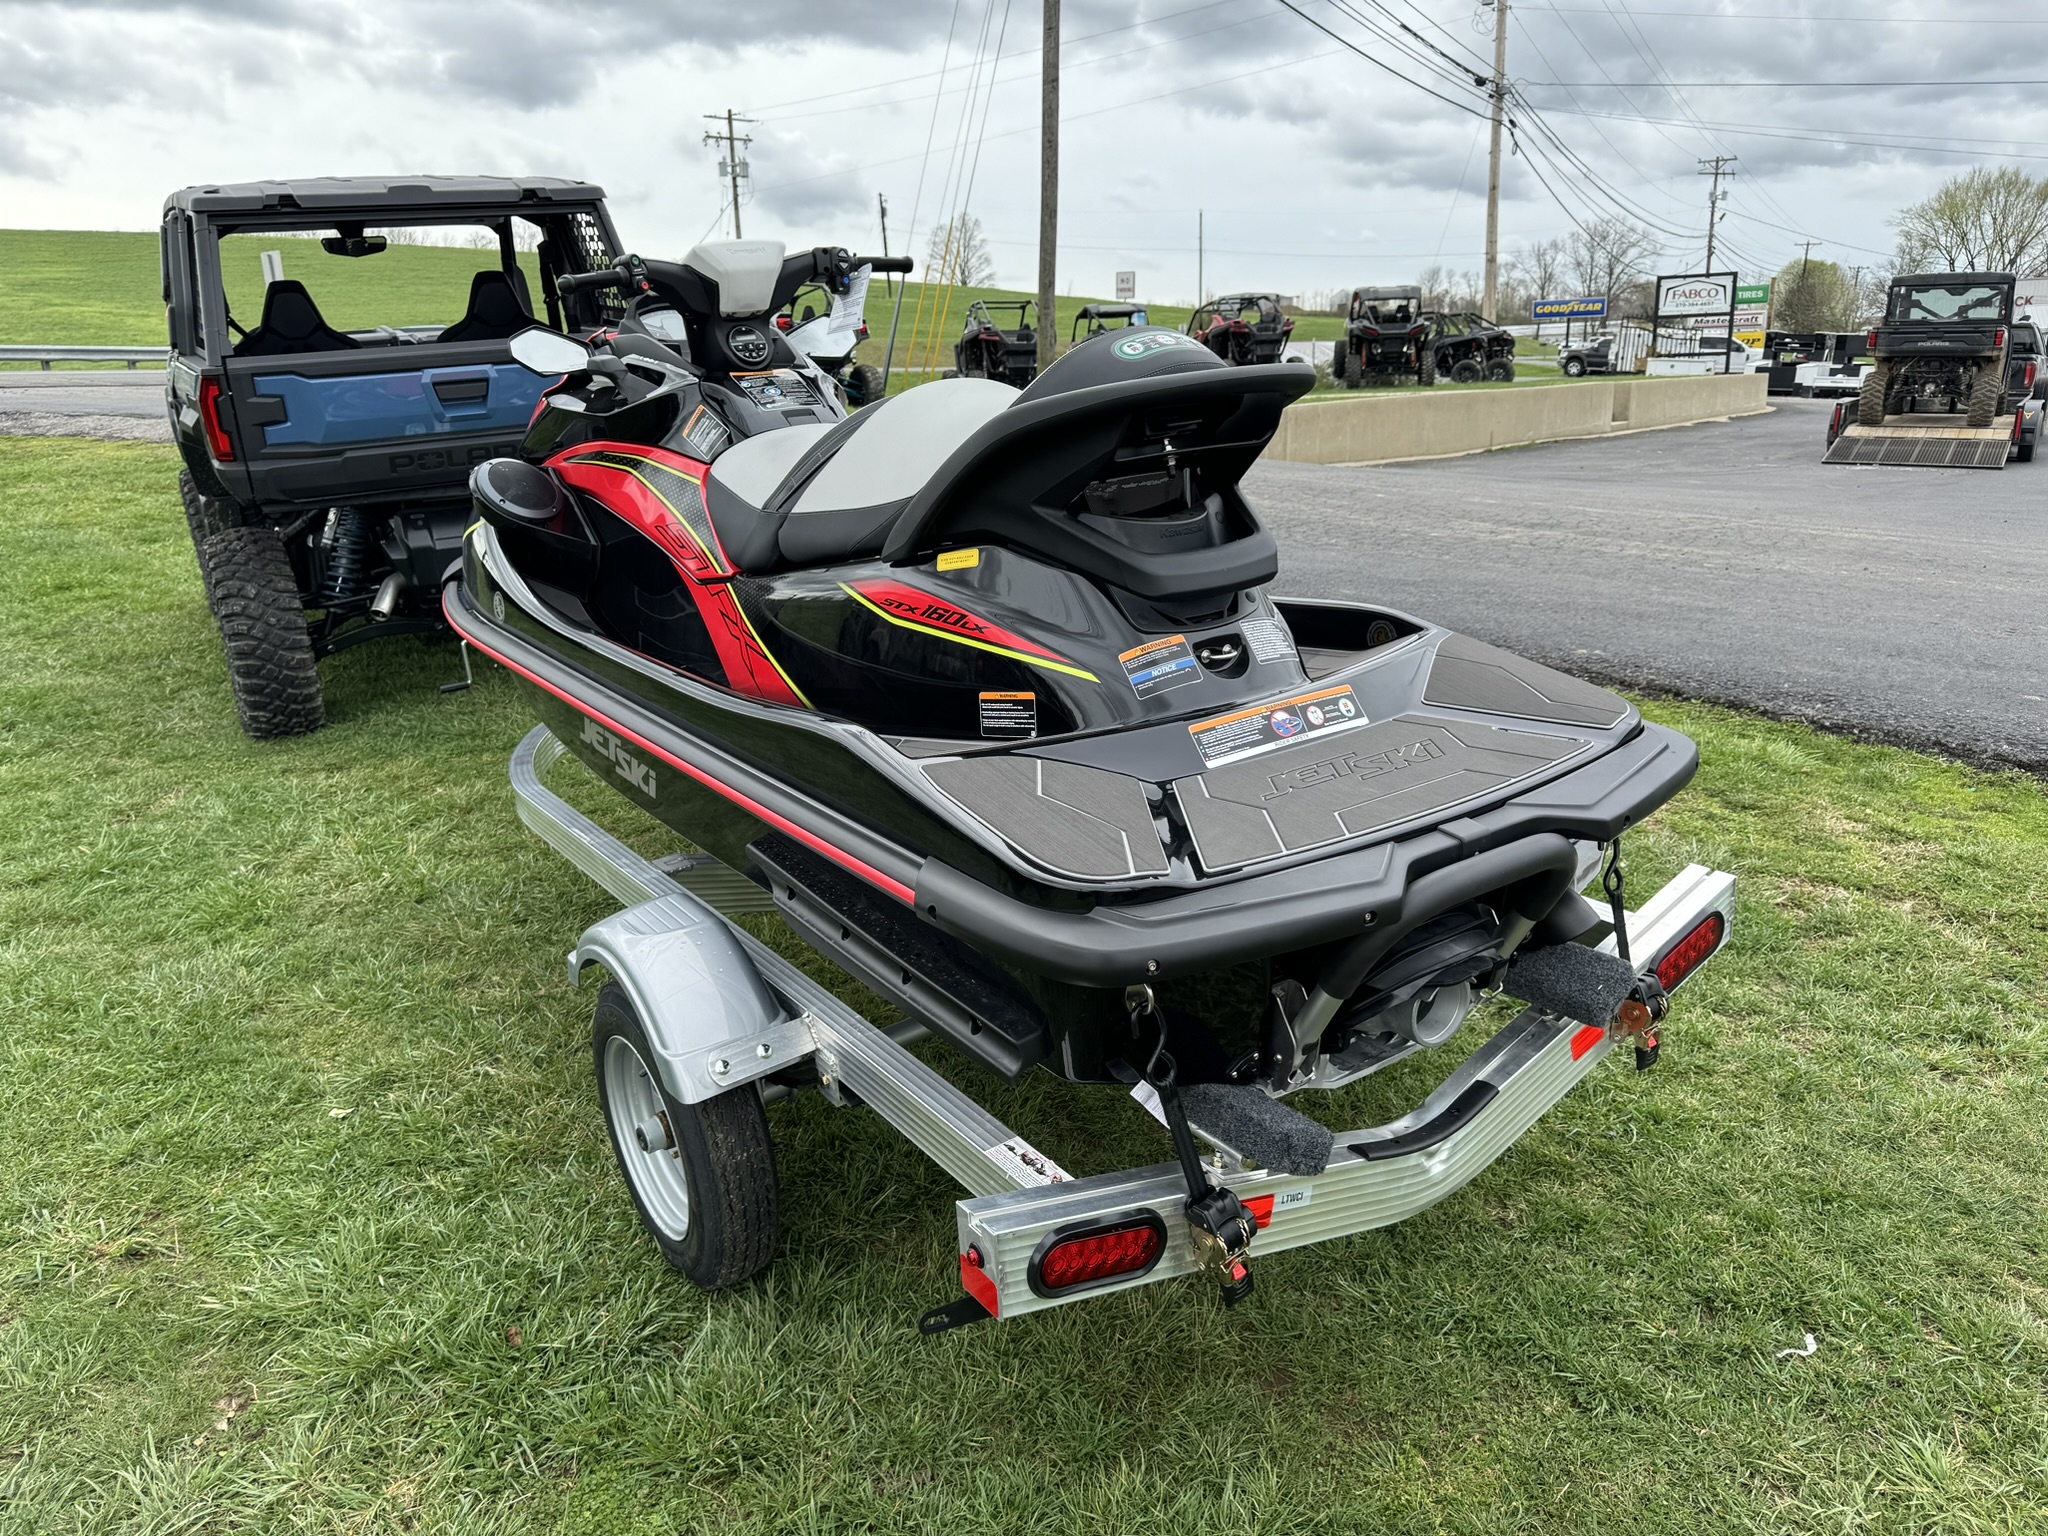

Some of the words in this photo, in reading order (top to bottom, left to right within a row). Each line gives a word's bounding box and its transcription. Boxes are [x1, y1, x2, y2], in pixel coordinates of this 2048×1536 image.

[1672, 288, 1719, 300] FABCO
[1738, 290, 1764, 299] TIRES
[1536, 301, 1603, 315] GOODYEAR
[1693, 315, 1759, 325] Mastecraft
[1139, 639, 1172, 653] WARNING
[1151, 664, 1178, 678] NOTICE
[1264, 700, 1292, 712] WARNING
[1274, 738, 1290, 747] RIDER
